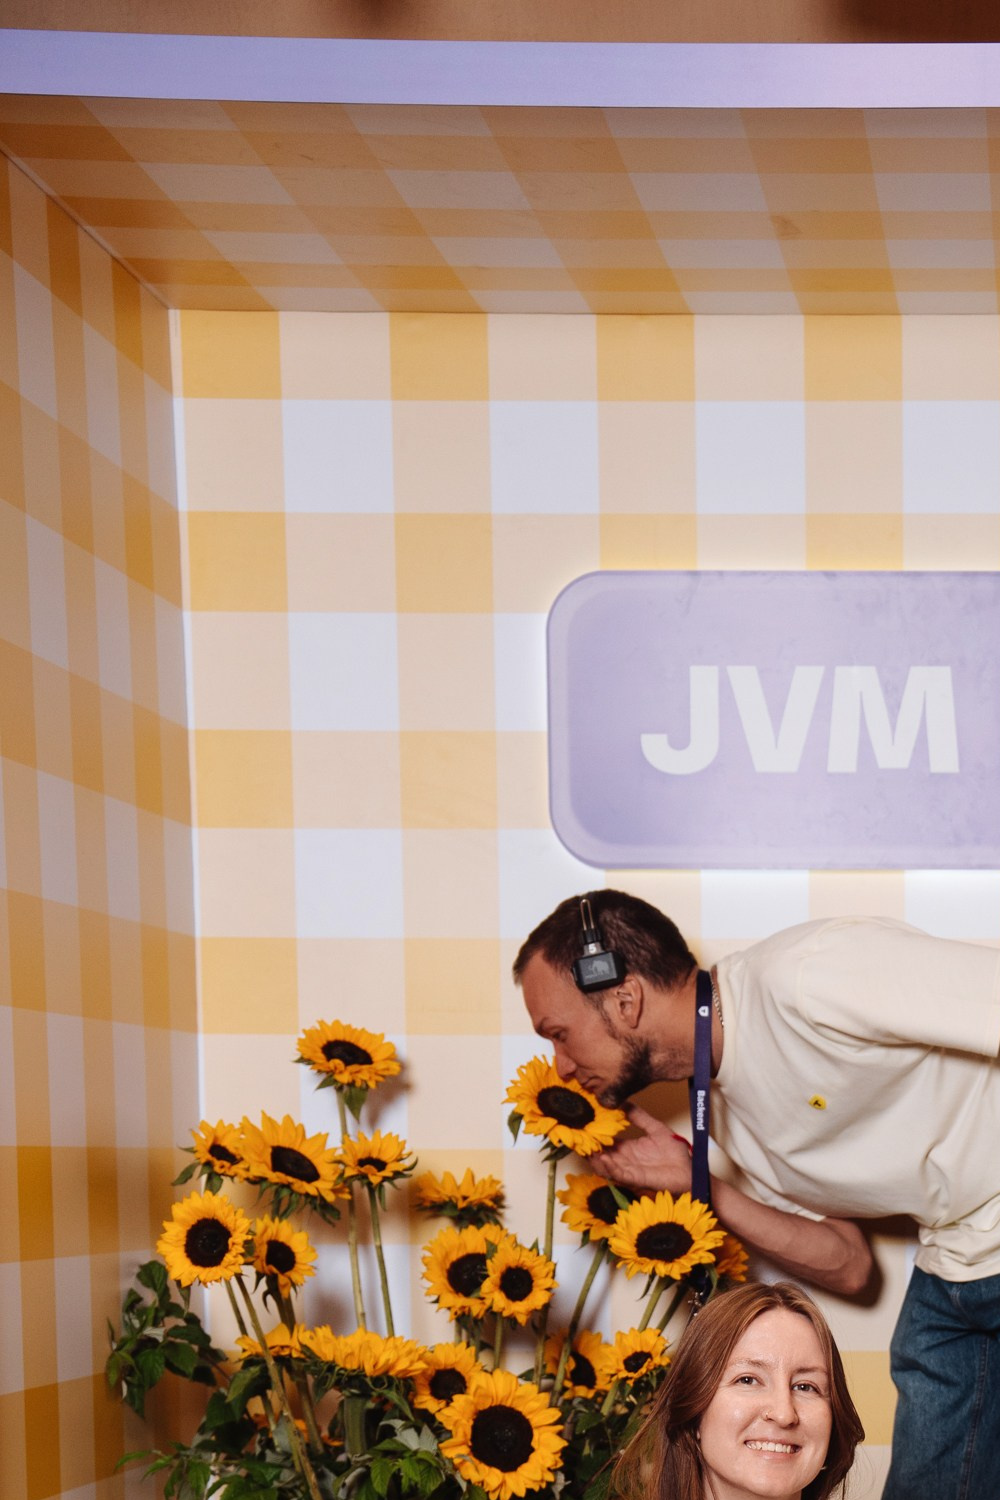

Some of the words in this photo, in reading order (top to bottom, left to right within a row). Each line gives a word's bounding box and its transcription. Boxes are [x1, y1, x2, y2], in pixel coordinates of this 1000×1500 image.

[640, 664, 960, 775] JVM
[588, 942, 598, 954] 5
[696, 1089, 706, 1131] Backend
